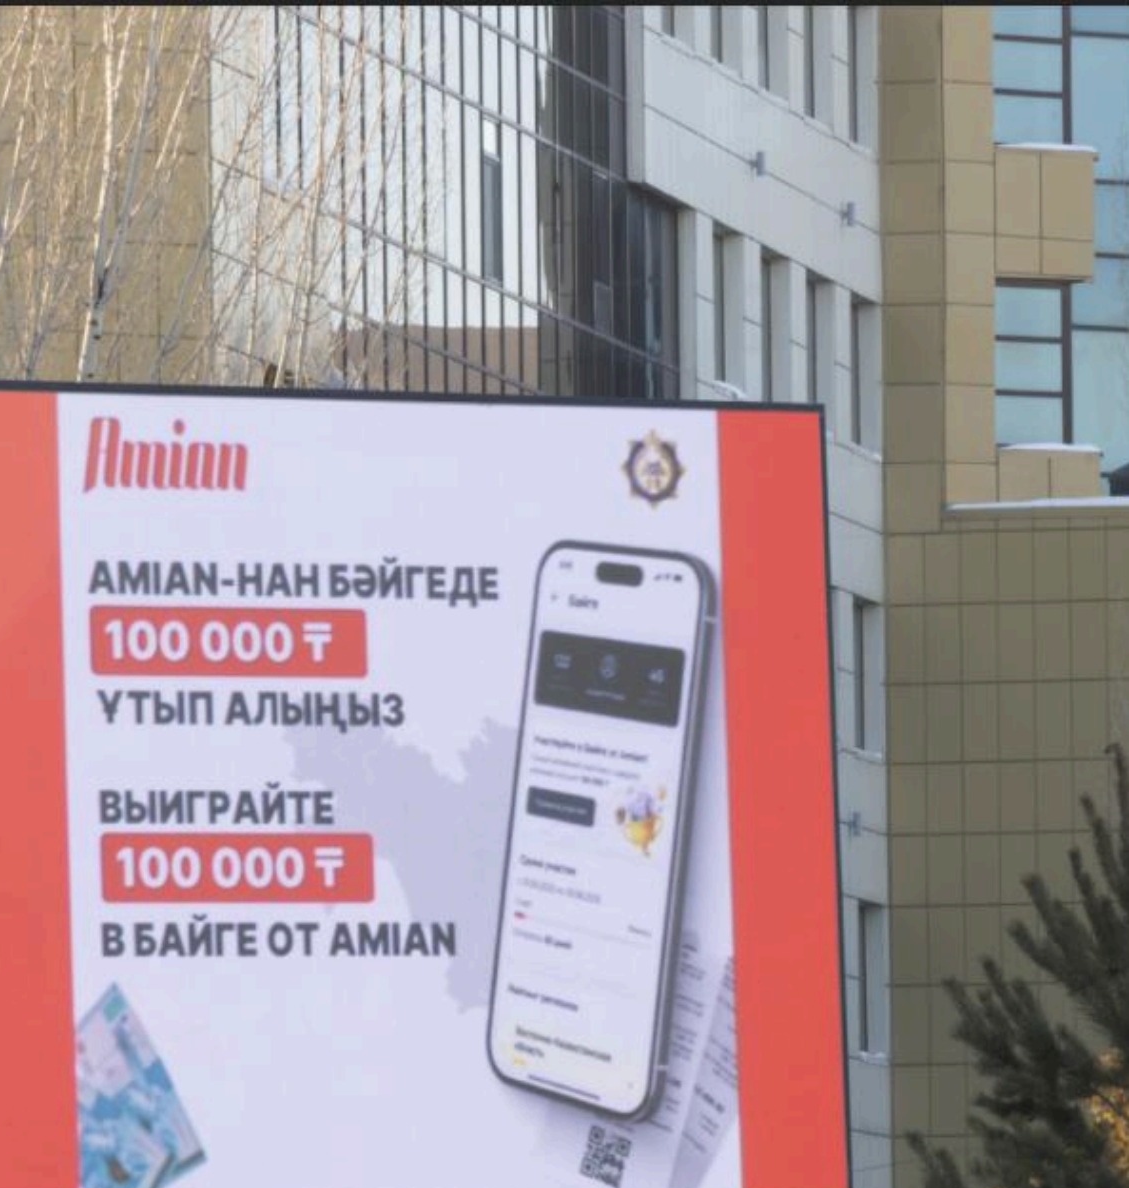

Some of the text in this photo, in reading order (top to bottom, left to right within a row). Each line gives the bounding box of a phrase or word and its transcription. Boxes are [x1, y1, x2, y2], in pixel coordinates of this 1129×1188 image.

[83, 416, 249, 492] Amian
[328, 556, 499, 608] БӘЙГЕДЕ
[105, 619, 190, 662] 100
[200, 620, 294, 663] 000
[96, 688, 405, 733] ҰТЫП АЛЫҢЫЗ
[98, 782, 336, 826] ВЫИГРАЙТЕ
[116, 846, 201, 888] 100
[211, 846, 305, 889] 000
[100, 914, 458, 958] В БАЙГЕ ОТ AMIAN
